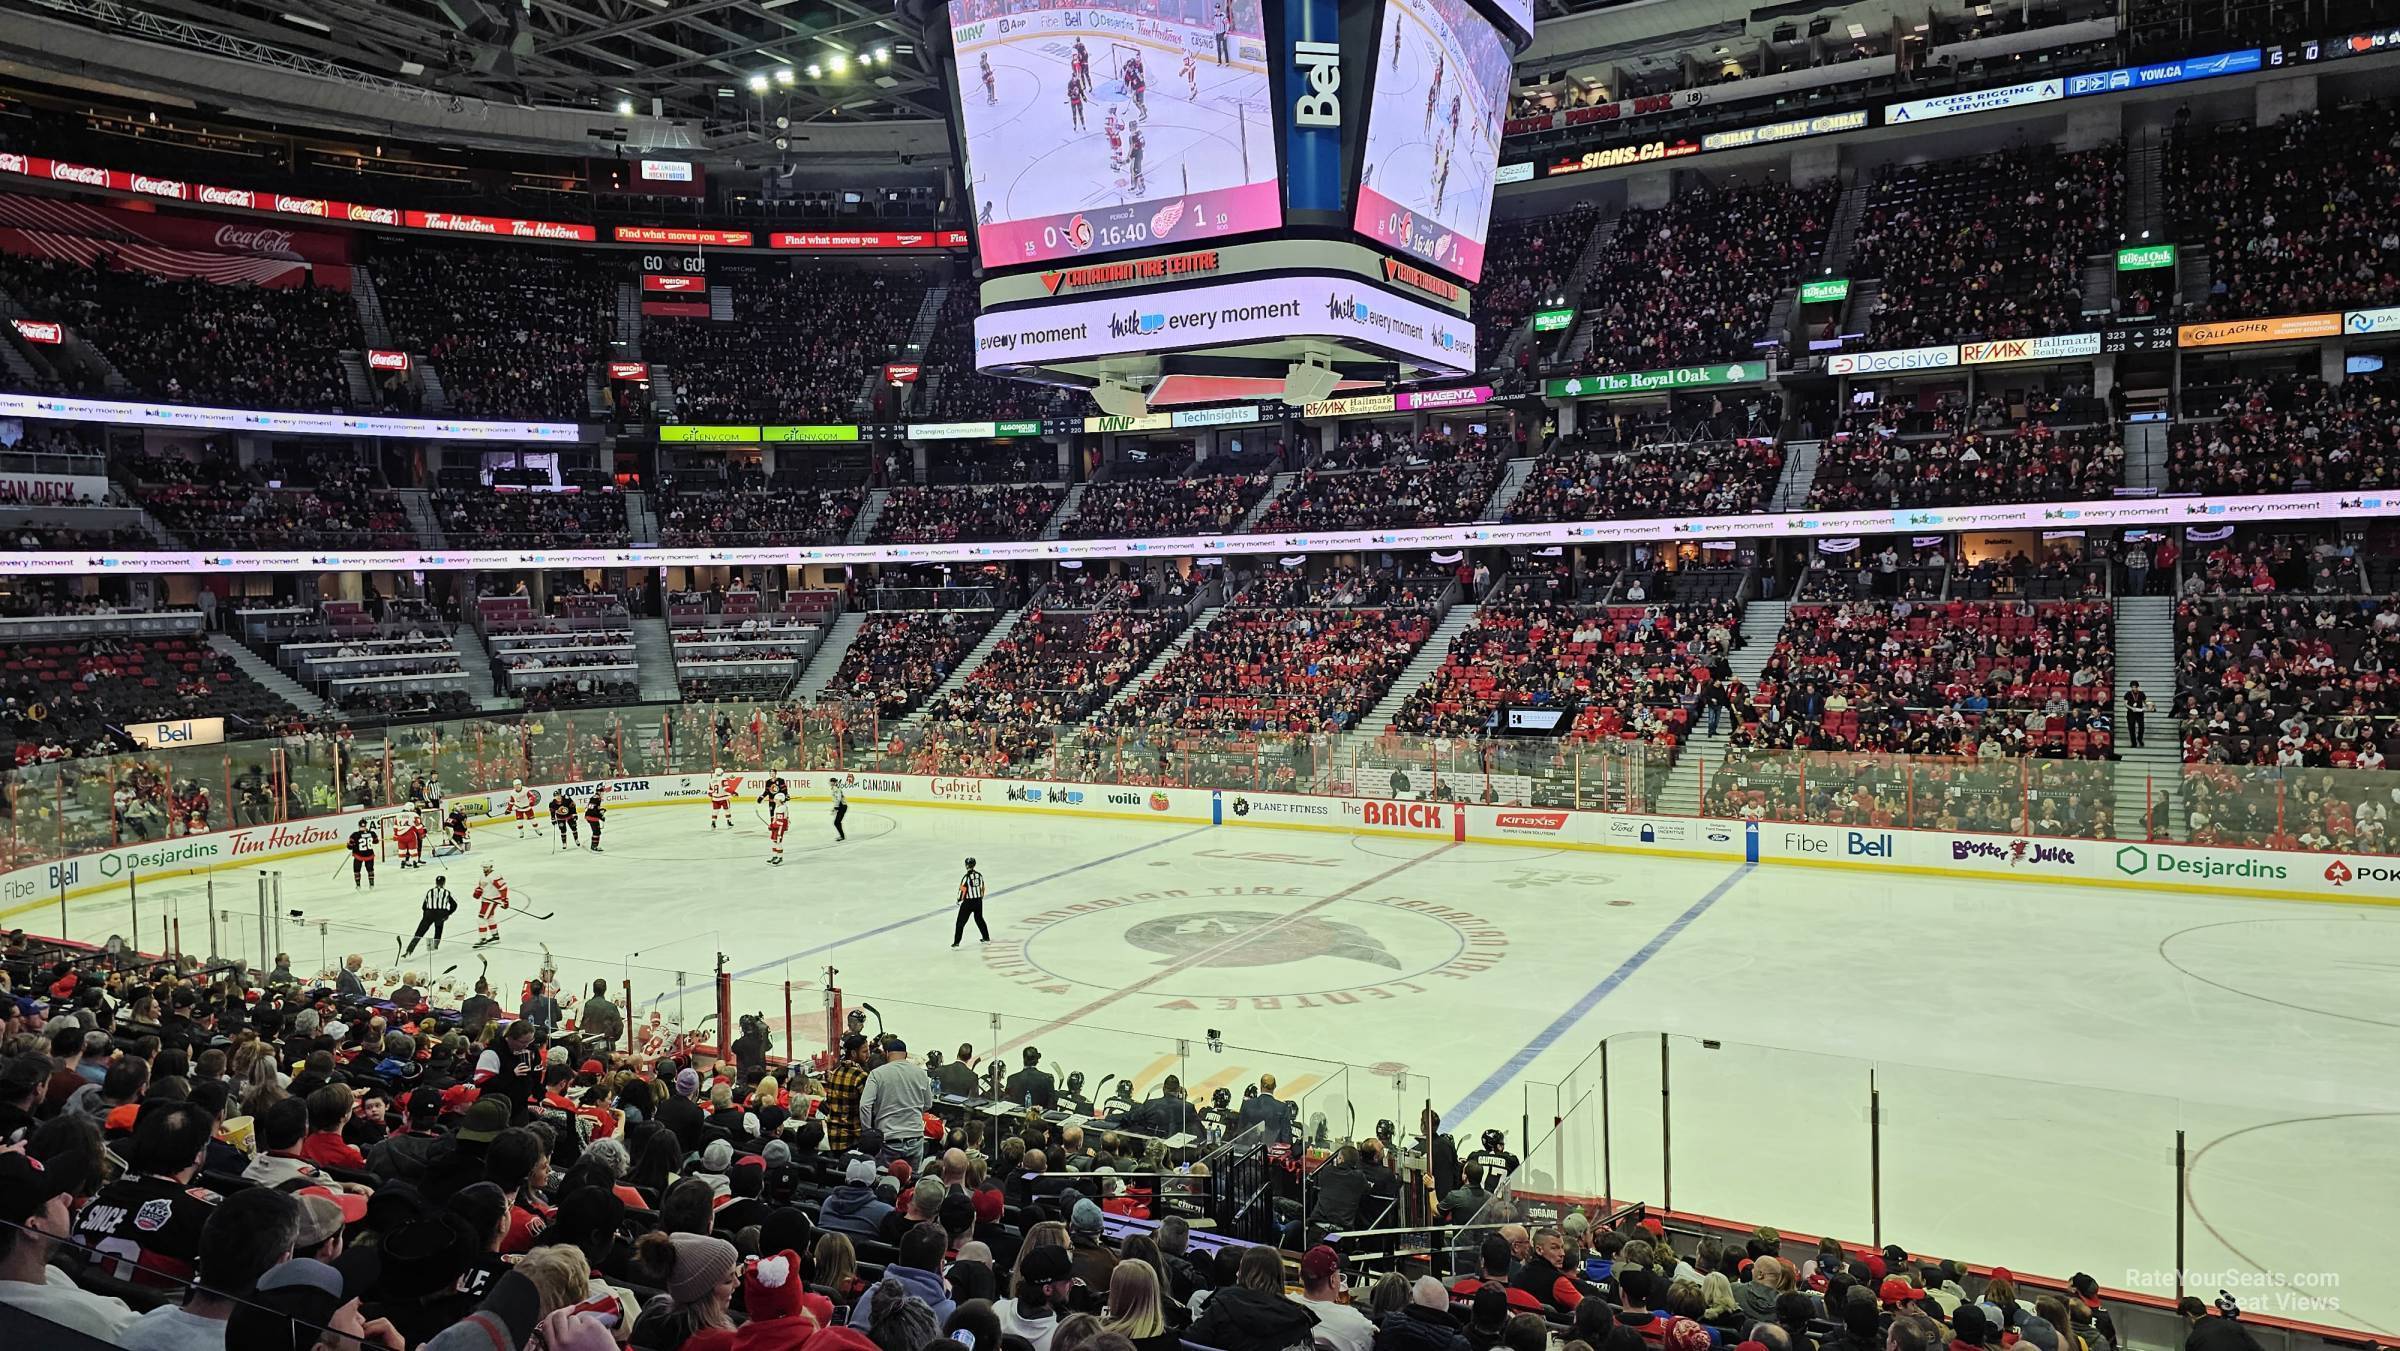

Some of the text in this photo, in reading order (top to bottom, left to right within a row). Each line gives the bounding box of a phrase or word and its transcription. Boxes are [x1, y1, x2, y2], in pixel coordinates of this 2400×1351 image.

[2371, 35, 2386, 47] to
[2306, 46, 2318, 60] 10
[2140, 65, 2182, 82] YOW.CA
[1296, 41, 1340, 126] Bell
[1686, 92, 1699, 102] 18
[1925, 85, 2035, 108] ACCESS RIGGING
[1947, 98, 2010, 113] SERVICES
[1581, 142, 1665, 170] SIGNS.CA
[55, 163, 105, 186] Coca-Cola
[135, 176, 182, 199] Coca-Cola
[203, 186, 250, 207] Coca-Cola
[279, 196, 323, 216] Coca-Cola
[1129, 208, 1135, 218] 2
[351, 206, 394, 225] Coca-Cola
[424, 213, 496, 234] Tim Hortons
[1193, 204, 1207, 227] 1
[1216, 213, 1228, 224] 10
[215, 224, 296, 252] Coca-Cola
[512, 221, 580, 240] Tim Hortons
[619, 228, 715, 244] Find what moves you
[1044, 227, 1057, 248] 0
[1100, 222, 1147, 246] 16:40
[785, 235, 879, 246] Find what moves you
[1025, 241, 1036, 250] 15
[643, 255, 706, 273] GO GO!
[1066, 252, 1218, 287] CANADIAN TIRE CENTRE
[1169, 311, 1217, 330] every
[1222, 300, 1300, 324] moment
[1369, 312, 1392, 333] every
[1392, 318, 1423, 341] moment
[2152, 328, 2173, 337] 324
[2195, 323, 2268, 341] GALLAGHER
[980, 323, 1087, 351] every moment
[2033, 336, 2097, 348] Hallmark
[2106, 331, 2126, 341] 323
[1455, 340, 1473, 359] every
[1964, 340, 2027, 361] RE/MAX
[2033, 344, 2098, 358] Realty Group
[2106, 343, 2126, 352] 223
[2152, 340, 2172, 349] 224
[1857, 349, 1949, 371] Decisive
[1597, 367, 1711, 391] The Royal Oak
[1350, 395, 1393, 406] Hallmark
[1423, 389, 1477, 401] MAGENTA
[1182, 408, 1249, 424] TechInsights
[1306, 400, 1347, 416] RE/MAX
[1350, 403, 1393, 413] Realty Group
[1098, 417, 1136, 432] MNP
[1262, 413, 1274, 421] 220
[915, 428, 945, 437] Changing
[34, 481, 75, 502] DECK
[2085, 506, 2169, 519] every moment
[2229, 505, 2264, 514] every
[2268, 501, 2321, 511] moment
[1822, 517, 1895, 529] every moment
[1947, 515, 1977, 524] every
[1980, 512, 2026, 521] moment
[1493, 529, 1551, 540] every moment
[1597, 526, 1660, 537] every moment
[1706, 521, 1774, 532] every moment
[0, 559, 73, 568] every moment
[122, 560, 148, 568] every
[157, 722, 193, 743] Bell
[613, 780, 650, 793] STAR
[793, 778, 811, 789] TIRE
[862, 778, 902, 793] CANADIAN
[930, 777, 982, 796] Gabriel
[946, 793, 982, 801] PIZZA
[1108, 791, 1141, 806] voilà
[1253, 802, 1328, 815] PLANET FITNESS
[1341, 801, 1441, 829] The BRICK
[1610, 821, 1634, 832] Ford
[229, 826, 338, 856] Tim Hortons
[358, 834, 373, 850] 28
[1785, 832, 1892, 858] Fibe Bell
[127, 842, 218, 868] Desjardins
[1952, 839, 2076, 865] Booster Juice
[2157, 853, 2288, 879] Desjardins
[3, 877, 35, 900] Fibe
[1477, 1155, 1507, 1168] GAUTHIER
[81, 1205, 128, 1234] SINCE
